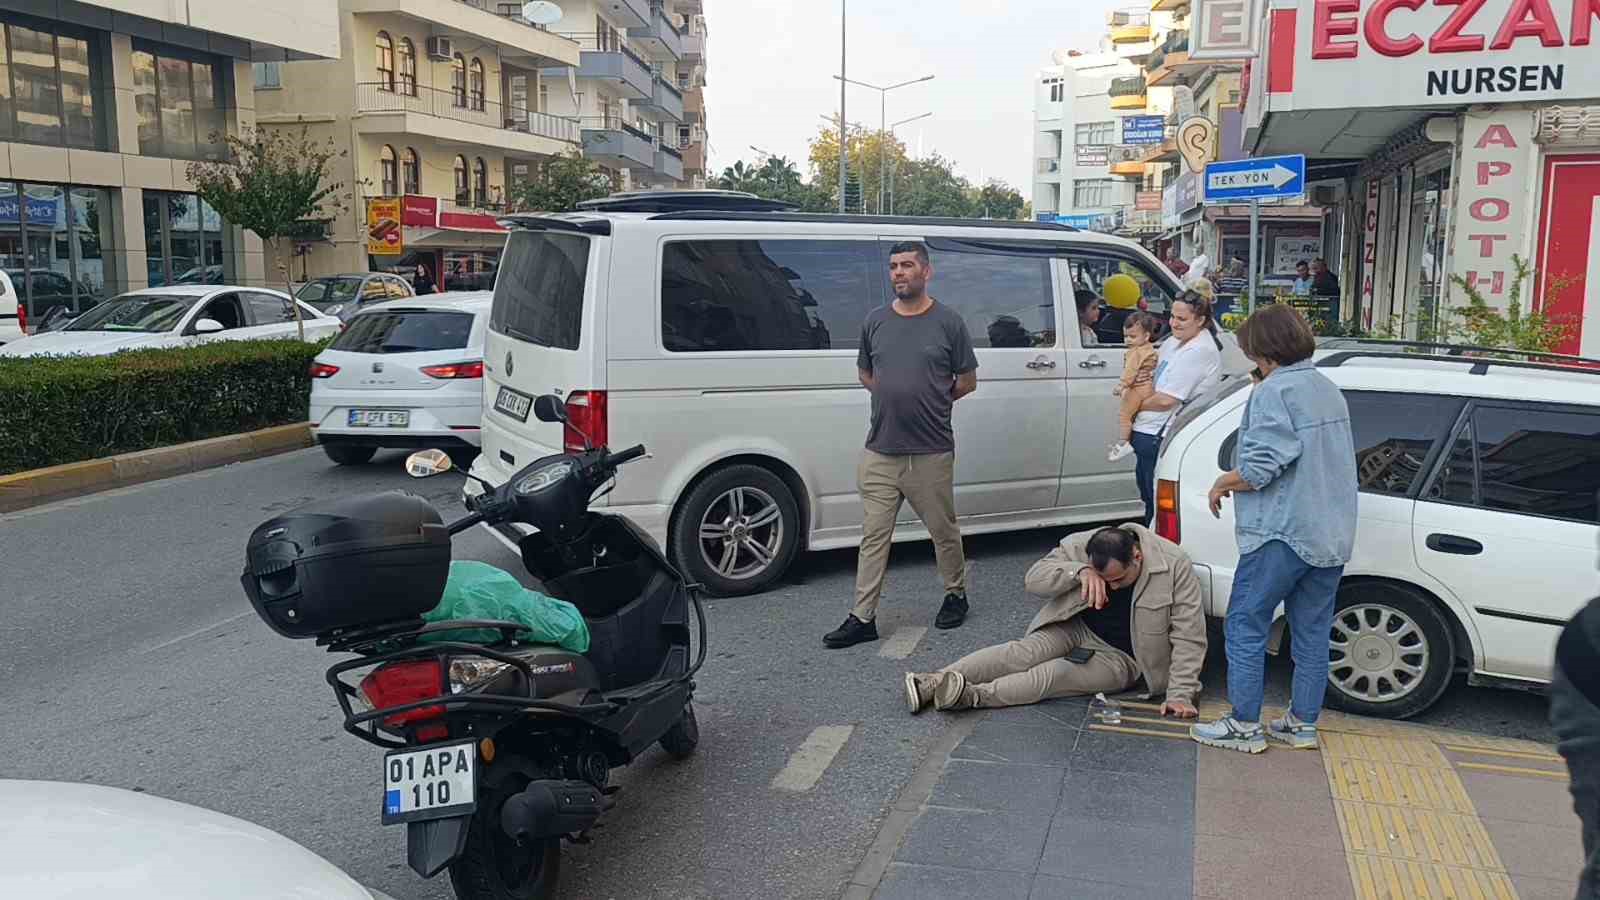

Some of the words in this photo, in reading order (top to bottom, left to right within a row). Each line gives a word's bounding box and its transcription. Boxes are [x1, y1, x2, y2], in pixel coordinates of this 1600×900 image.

[1425, 63, 1564, 97] NURSEN
[1214, 175, 1236, 186] TEK
[1243, 171, 1270, 184] YÖN
[1465, 124, 1518, 312] APOTH
[390, 757, 415, 783] 01
[422, 748, 469, 779] APA
[412, 780, 451, 808] 110
